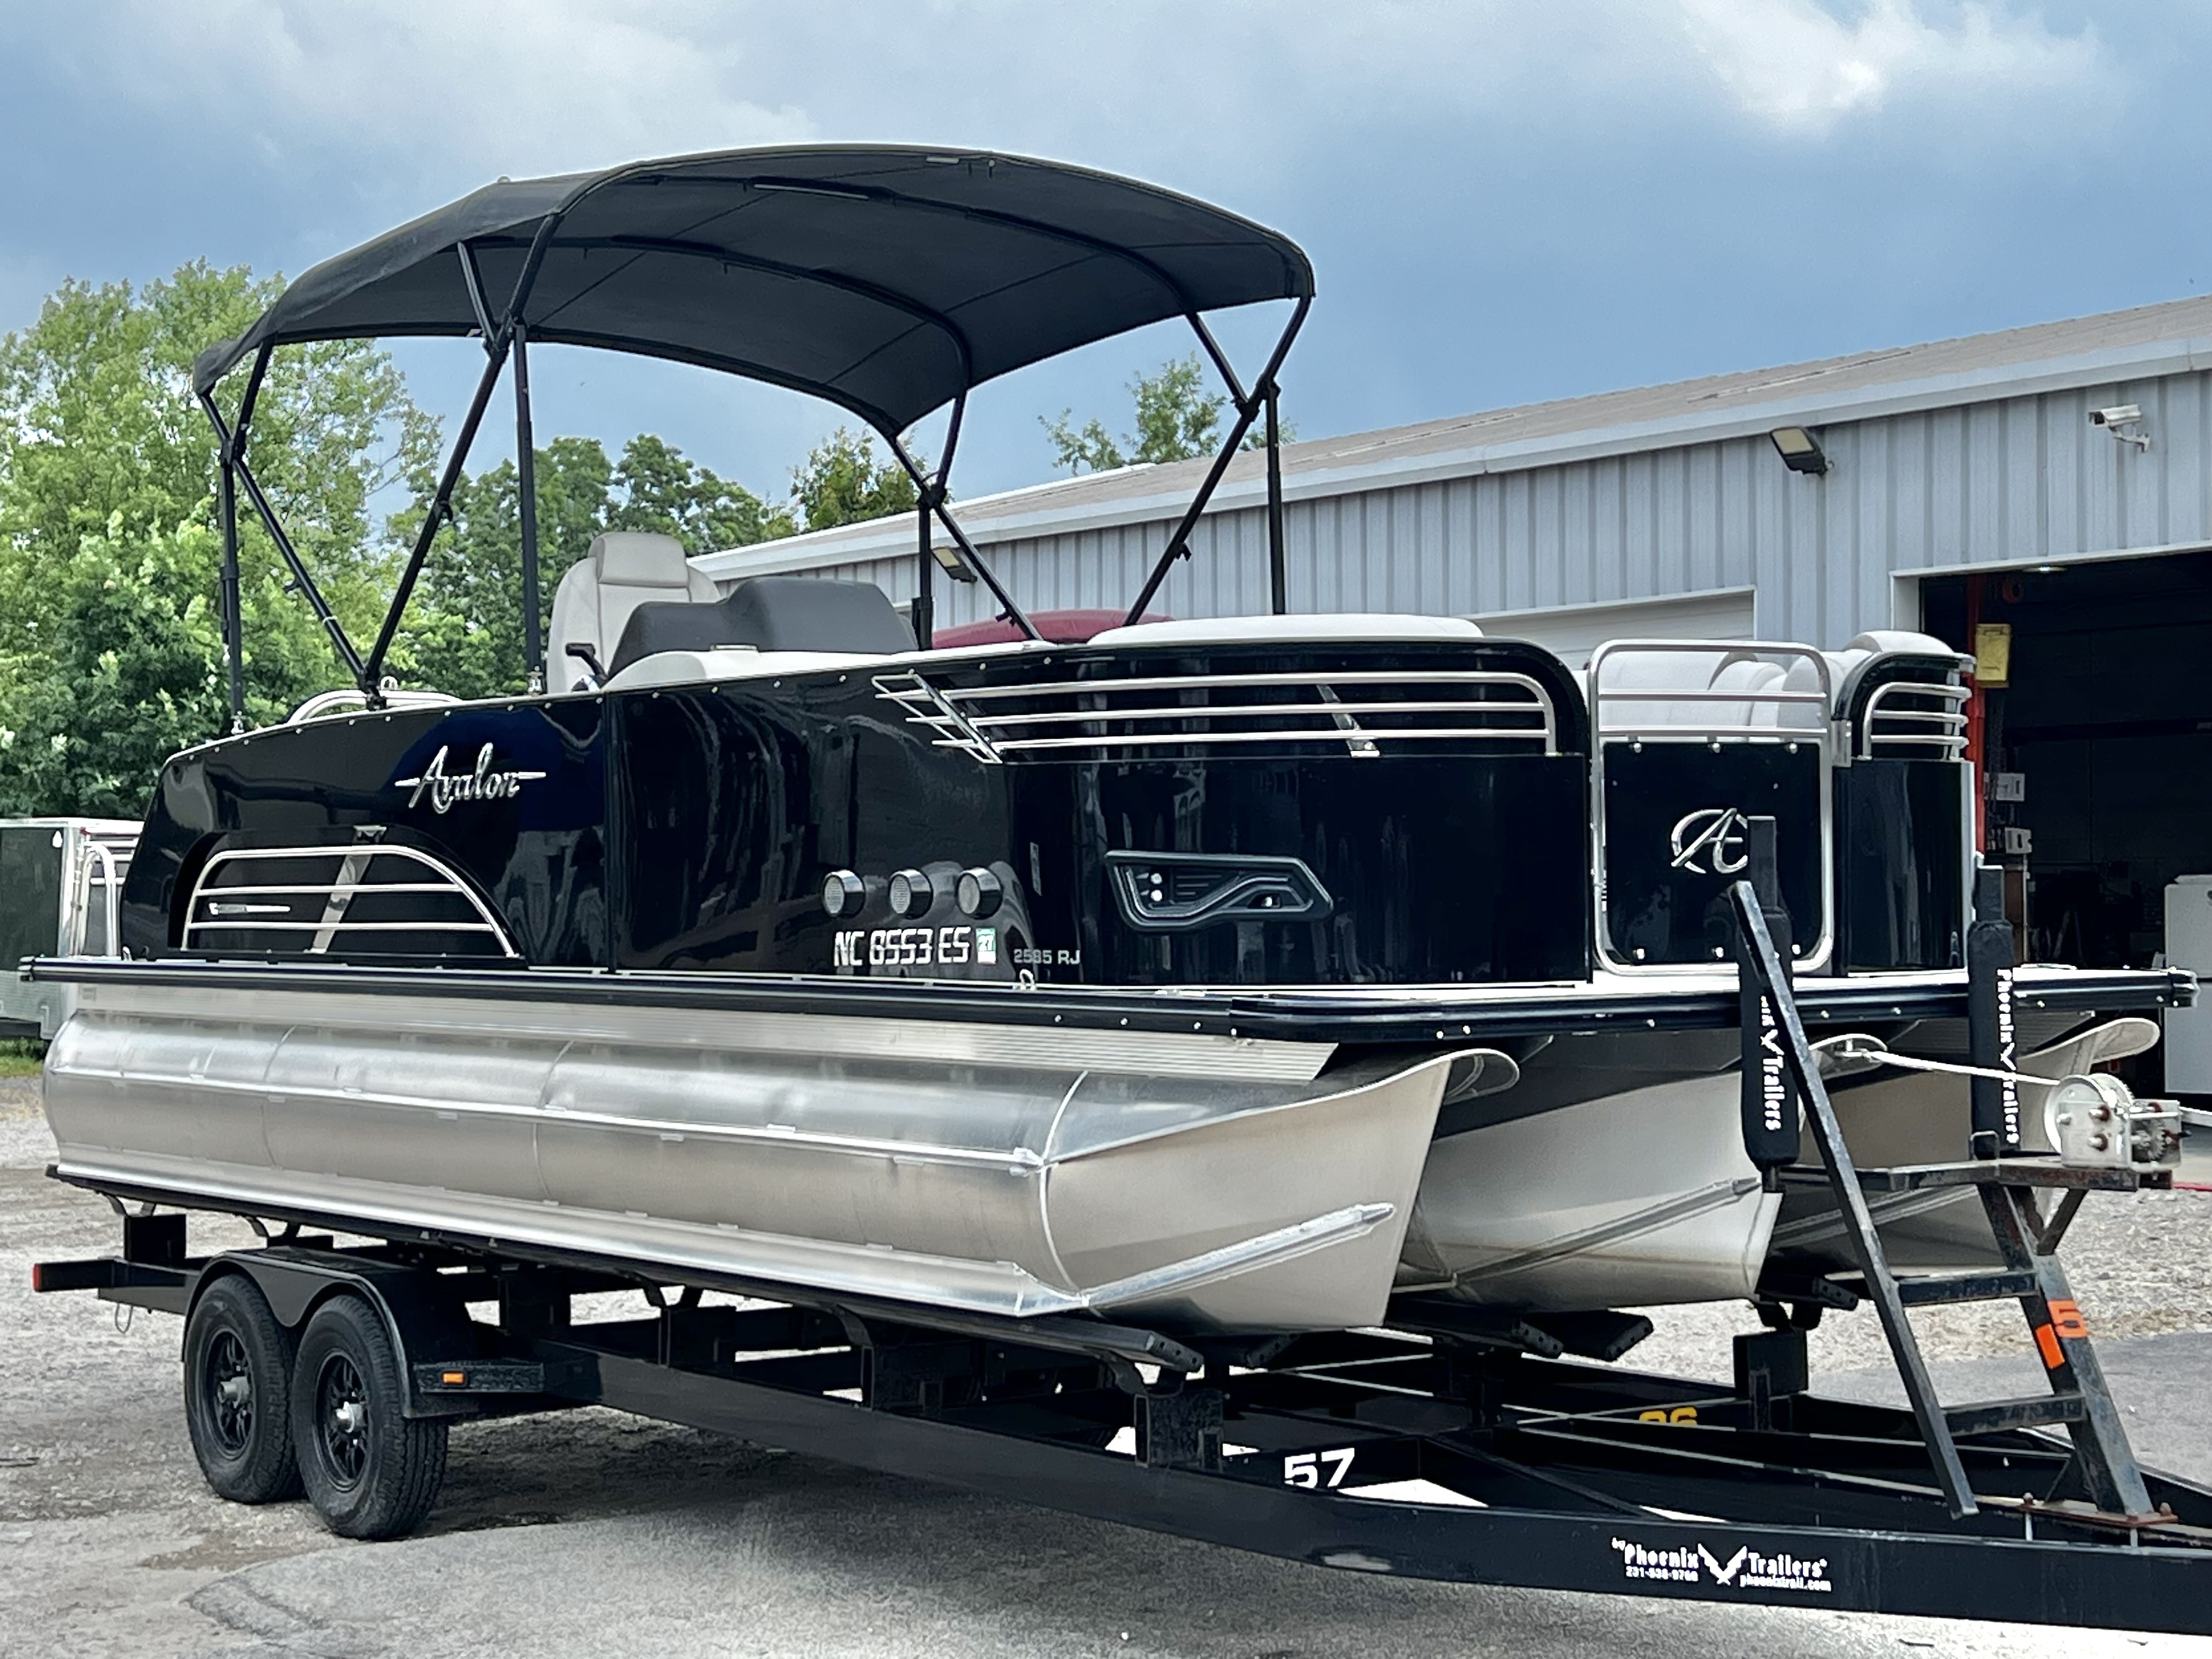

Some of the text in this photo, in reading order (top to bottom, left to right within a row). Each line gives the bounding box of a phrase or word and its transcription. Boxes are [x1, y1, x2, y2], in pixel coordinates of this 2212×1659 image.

[408, 742, 520, 814] Avalon
[834, 926, 971, 967] NC 8553 ES
[978, 934, 994, 951] 27
[1014, 949, 1080, 965] 2585 RJ
[1996, 969, 2014, 1043] Phoenix
[1763, 1056, 1785, 1131] Trailers
[1284, 1447, 1355, 1489] 57
[1624, 1543, 1699, 1569] Phoenix
